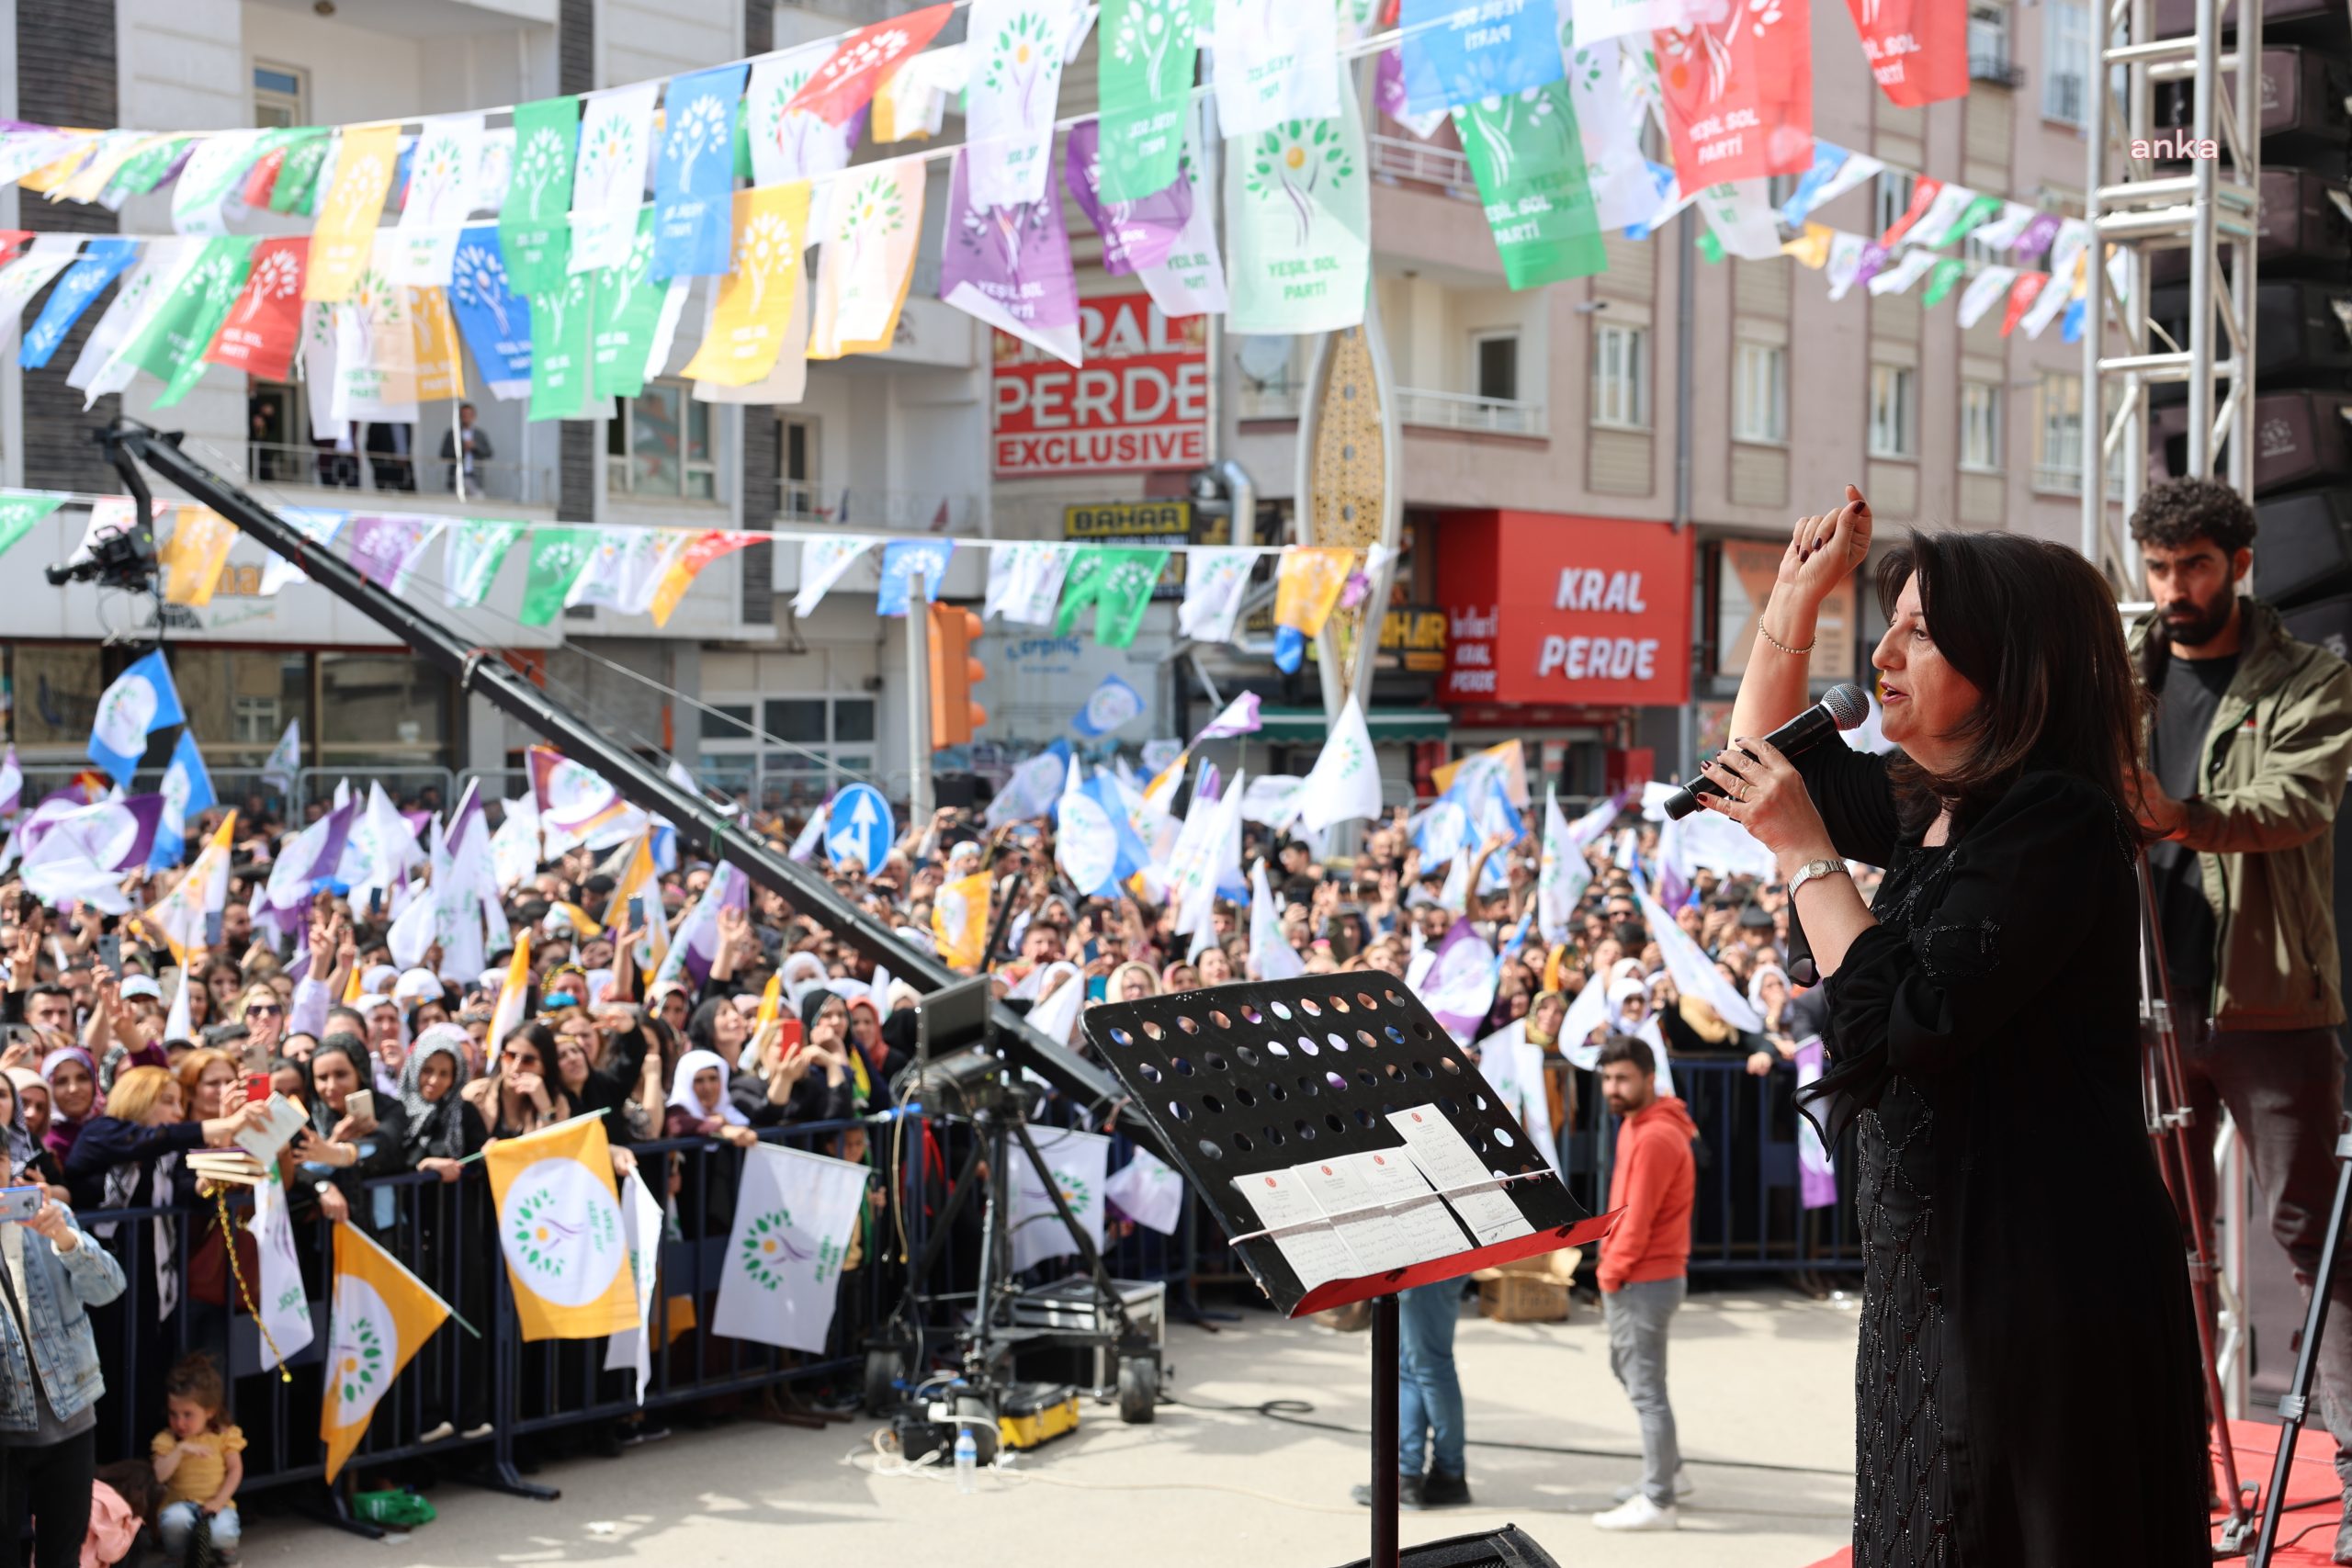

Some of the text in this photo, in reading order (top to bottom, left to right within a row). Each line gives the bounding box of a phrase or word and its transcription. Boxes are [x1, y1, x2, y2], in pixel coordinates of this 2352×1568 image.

[1883, 33, 1921, 56] SOL
[1724, 107, 1760, 131] SOL
[1698, 133, 1744, 166] PARTİ
[1517, 193, 1554, 217] SOL
[1267, 254, 1340, 278] YEŞİL SOL
[1283, 280, 1328, 301] PARTİ
[994, 363, 1206, 430] PERDE
[997, 430, 1204, 468] EXCLUSIVE
[1074, 507, 1181, 533] BAHAR
[1555, 566, 1647, 614] KRAL
[1538, 635, 1660, 681] PERDE
